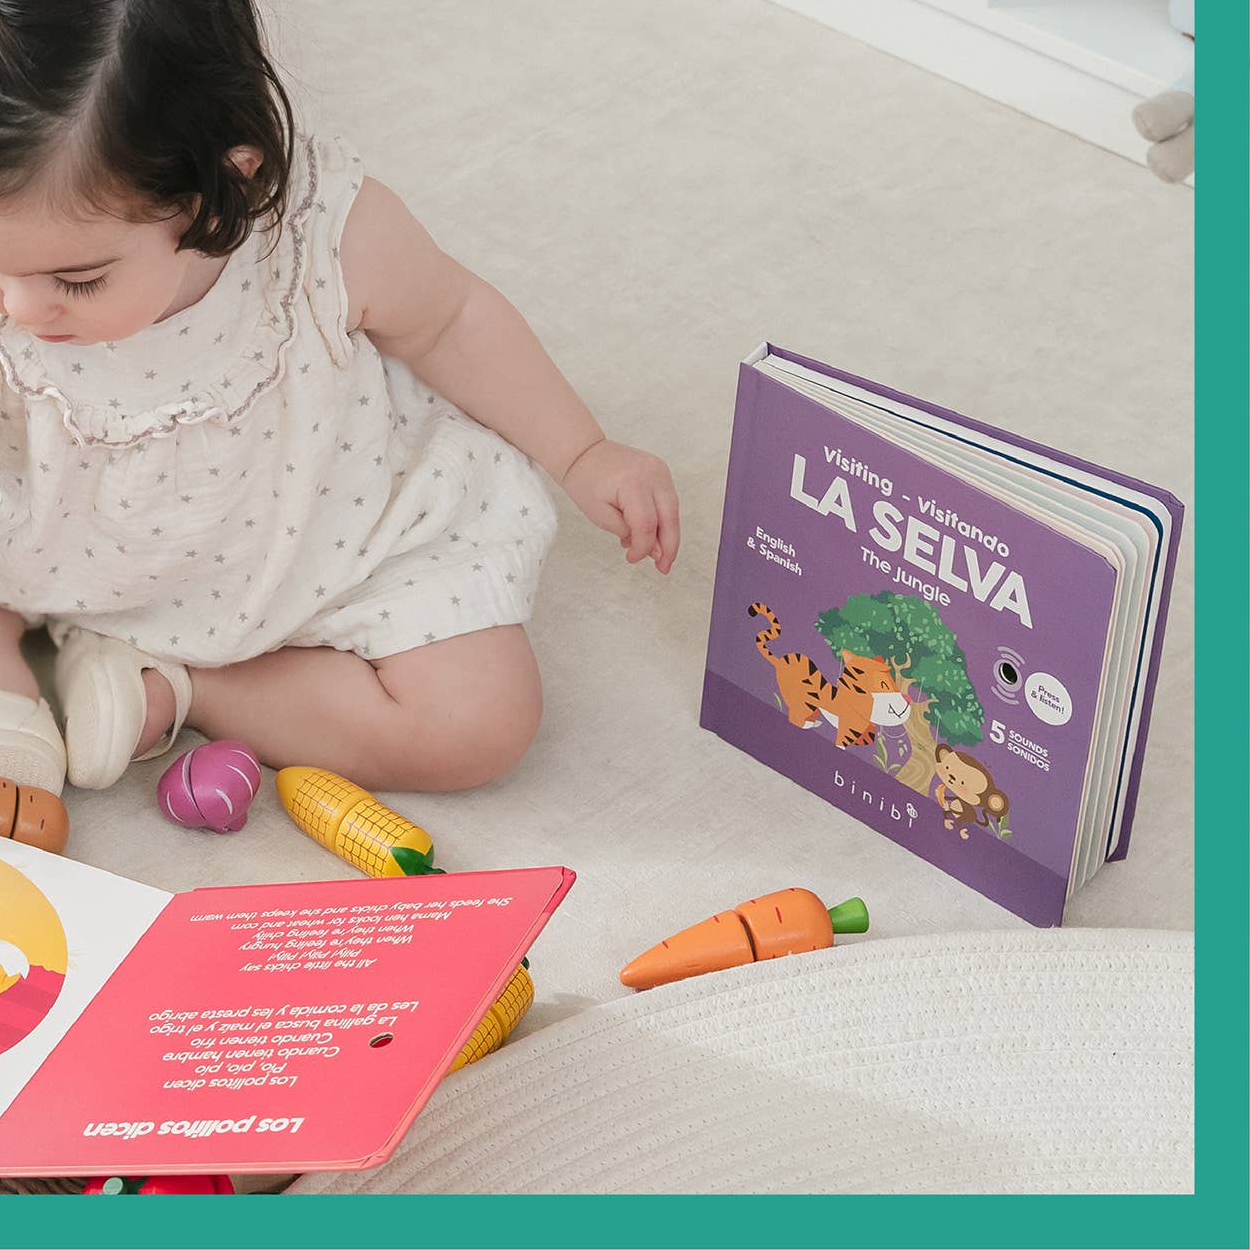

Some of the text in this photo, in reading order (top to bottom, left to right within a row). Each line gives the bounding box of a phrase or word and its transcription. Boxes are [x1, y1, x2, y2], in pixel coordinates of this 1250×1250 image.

[824, 446, 894, 496] visiting
[917, 496, 1010, 558] visitando
[756, 525, 796, 557] English
[790, 453, 1033, 630] LA SELVA
[747, 536, 802, 576] & Spanish
[861, 546, 951, 606] The Jungle
[1038, 685, 1060, 703] Press
[1039, 694, 1065, 714] listen!
[989, 719, 1006, 744] 5
[1009, 730, 1048, 757] SOUNDS
[1007, 742, 1050, 771] SONIDOS
[834, 770, 918, 828] binibi
[190, 897, 513, 921] She feeds her baby chicks and she keeps them warm
[231, 911, 452, 931] Mama hen looks for wheat and corn
[377, 925, 414, 933] When
[251, 930, 284, 940] chilly
[286, 929, 330, 938] feeling
[376, 935, 413, 944] When
[238, 941, 283, 950] hungry
[284, 940, 328, 950] feeling
[239, 959, 378, 973] All the little chicks say
[148, 1001, 419, 1022] Les da la comida y les presta abrigo
[204, 1021, 220, 1031] y
[255, 1021, 272, 1033] el
[275, 1019, 323, 1030] busca
[324, 1013, 378, 1029] gallina
[380, 1016, 398, 1027] La
[150, 1023, 185, 1036] trigo
[185, 1024, 203, 1036] el
[219, 1035, 268, 1046] tienen
[271, 1032, 333, 1046] Cuando
[162, 1046, 340, 1063] Cuando tienen hambre
[194, 1061, 225, 1076] pío
[162, 1073, 298, 1091] Los pollitos dicen
[83, 1115, 305, 1140] Los pollitos dicen
